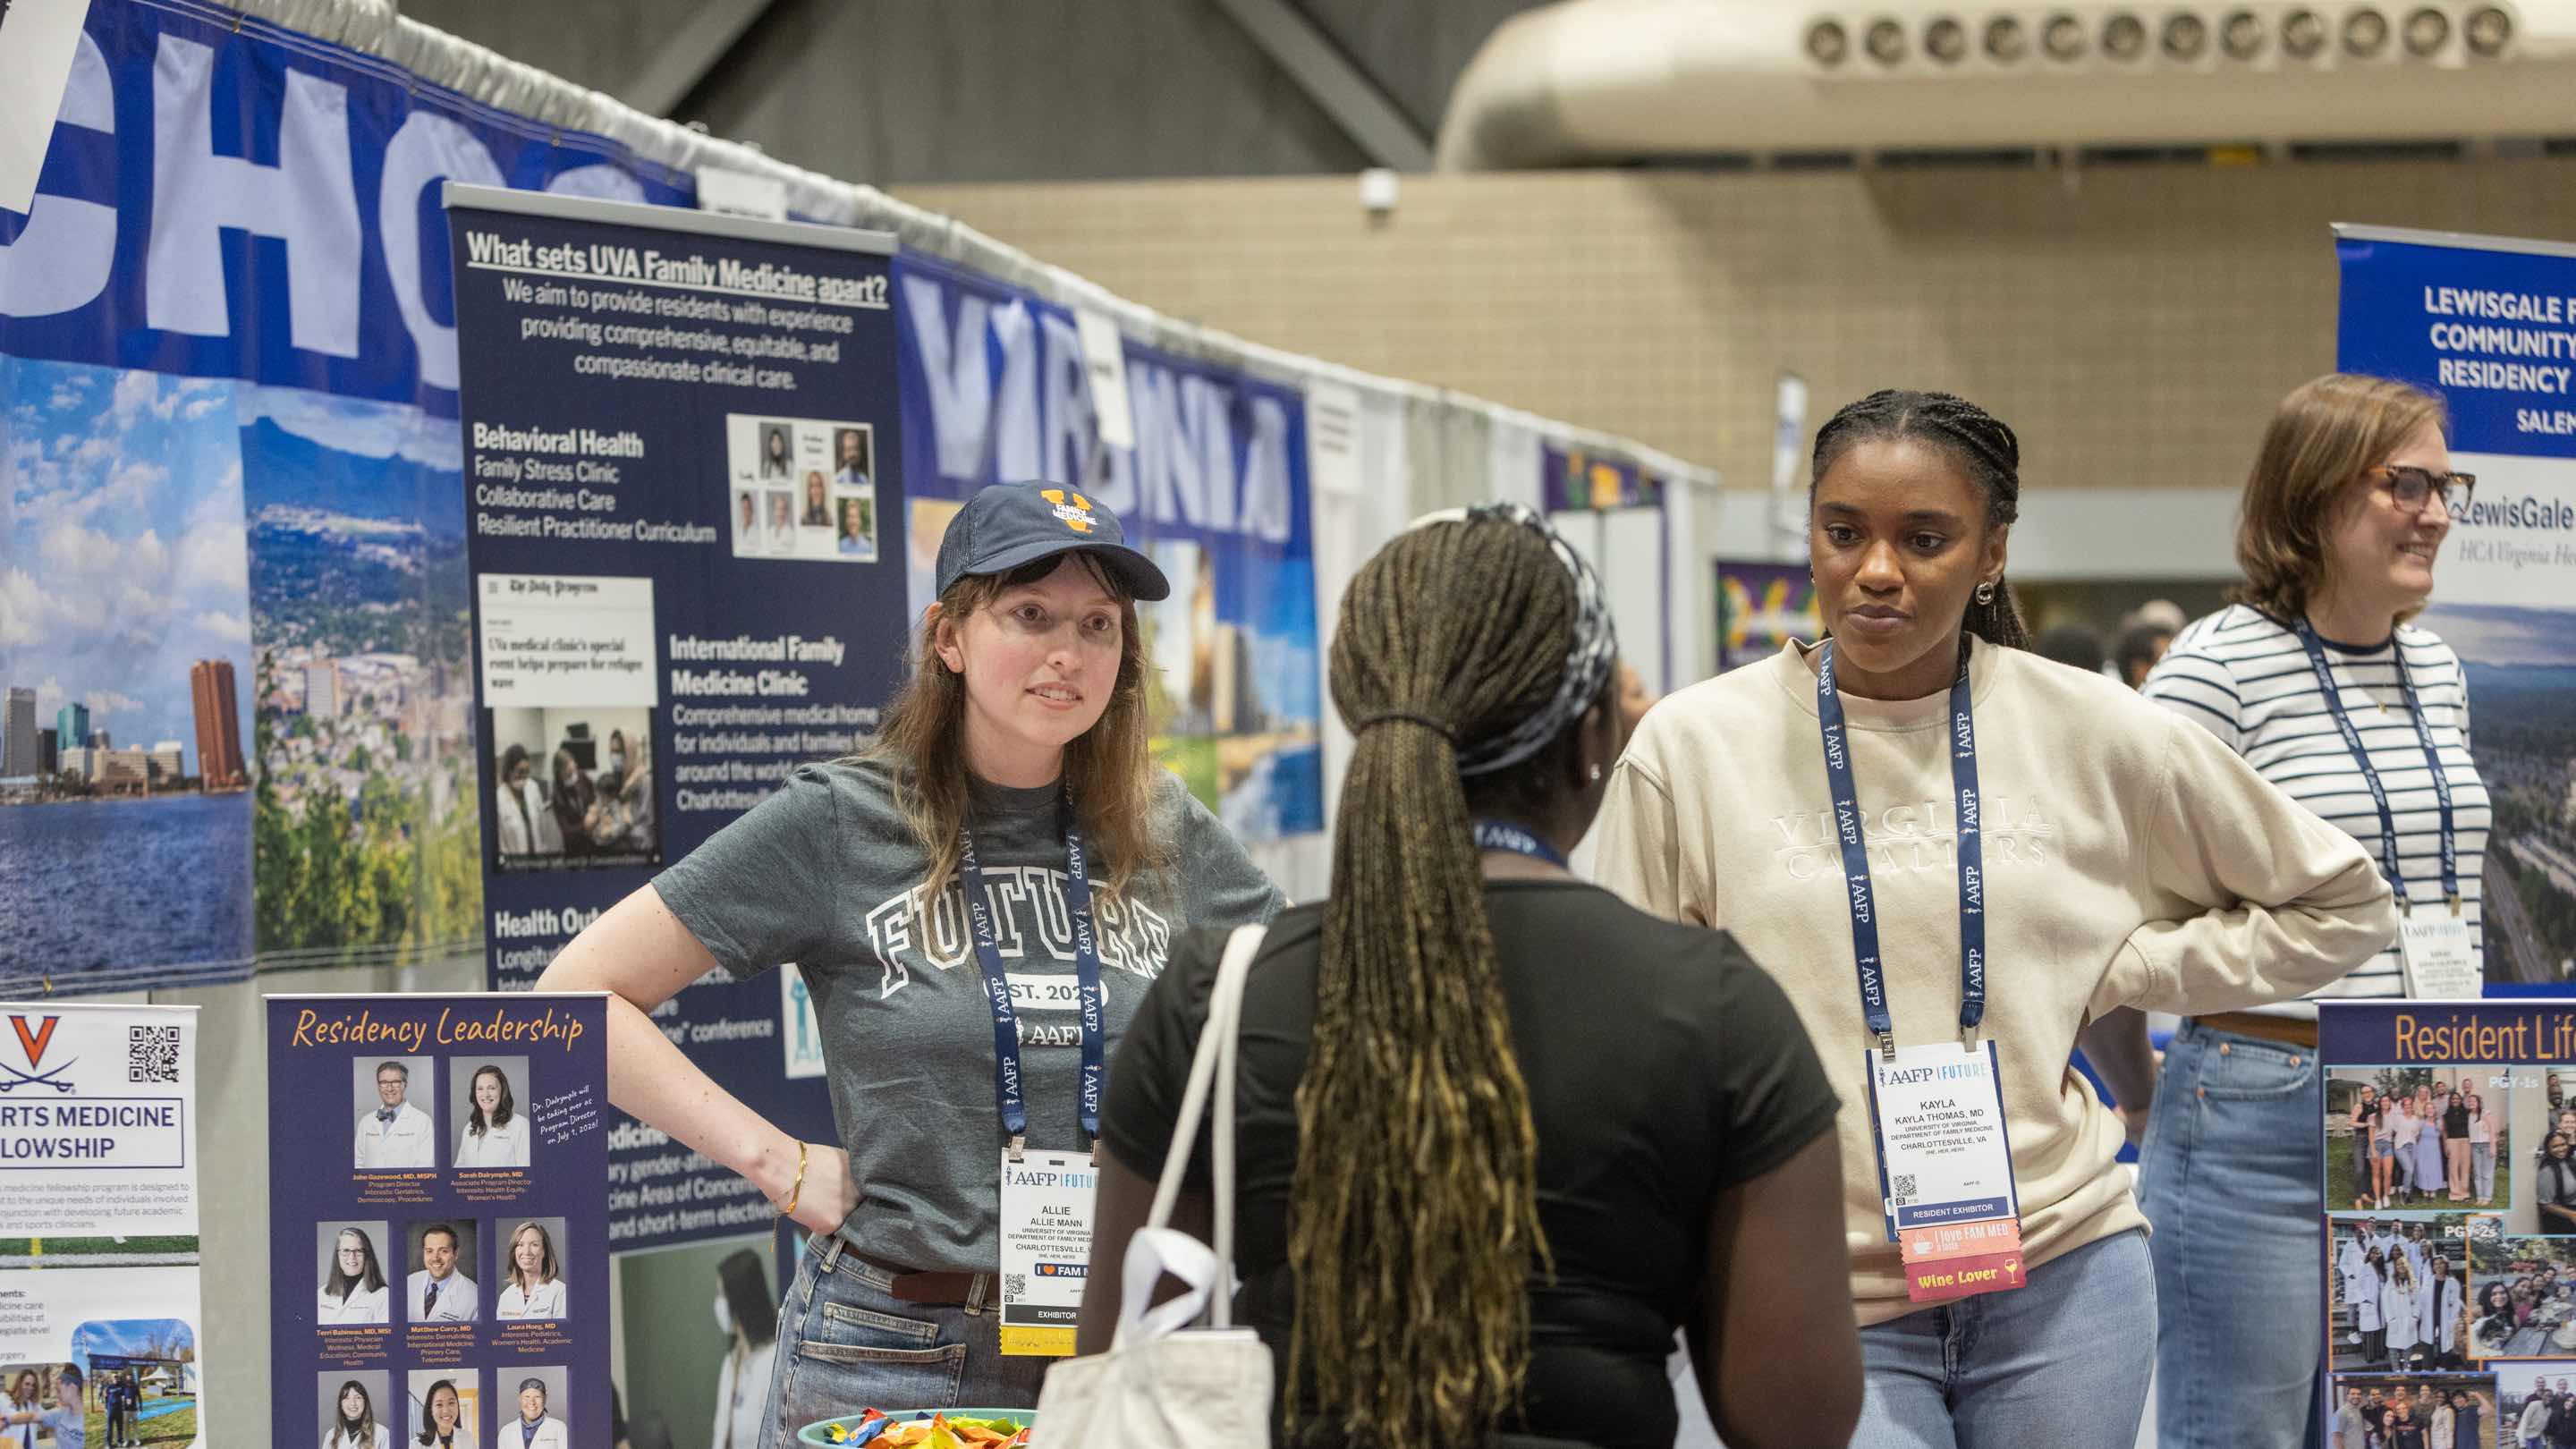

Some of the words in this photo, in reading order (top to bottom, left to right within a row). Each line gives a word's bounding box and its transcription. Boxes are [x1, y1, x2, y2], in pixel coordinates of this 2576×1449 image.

[467, 232, 532, 267] What
[537, 244, 587, 274] sets
[590, 246, 640, 278] UVA
[645, 251, 716, 288] Family
[719, 262, 814, 297] Medicine
[818, 275, 887, 306] apart?
[504, 278, 532, 302] We
[535, 284, 567, 306] aim
[570, 287, 589, 308] to
[592, 287, 652, 317] provide
[655, 297, 731, 323] residents
[733, 302, 766, 326] with
[768, 308, 853, 334] experience
[2425, 285, 2562, 323] LEWISGALE
[521, 316, 602, 345] providing
[605, 325, 731, 355] comprehensive,
[732, 334, 808, 361] equitable,
[809, 342, 839, 362] and
[575, 355, 699, 383] compassionate
[702, 361, 754, 386] clinical
[757, 369, 796, 390] care.
[2439, 358, 2571, 394] RESIDENCY
[474, 423, 576, 453] Behavioral
[580, 430, 644, 458] Health
[475, 455, 521, 482] Family
[525, 457, 572, 482] Stress
[576, 461, 620, 484] Clinic
[477, 484, 574, 510] Collaborative
[577, 489, 615, 512] Care
[1055, 504, 1087, 516] FAMILY
[478, 513, 540, 538] Resilient
[544, 515, 632, 540] Practitioner
[635, 520, 716, 542] Curriculum
[1053, 509, 1098, 526] MEDICINE
[510, 638, 549, 651] medical
[552, 639, 587, 651] clinic's
[590, 640, 625, 654] special
[671, 634, 784, 661] International
[787, 635, 844, 665] Family
[518, 657, 544, 672] helps
[547, 660, 588, 674] prepare
[591, 657, 605, 669] for
[672, 671, 755, 696] Medicine
[758, 672, 808, 696] Clinic
[1820, 664, 1831, 696] AAFP
[673, 704, 782, 727] Comprehensive
[784, 705, 835, 725] medical
[837, 705, 878, 725] home
[674, 731, 695, 752] for
[699, 731, 771, 752] individuals
[773, 732, 800, 752] and
[802, 731, 850, 751] families
[1957, 712, 1971, 749] AAFP
[1826, 734, 1843, 770] AAFP
[675, 761, 733, 783] around
[734, 761, 756, 782] the
[758, 761, 792, 781] world
[1770, 795, 2048, 843] VIRGIIA
[1962, 789, 1977, 826] AAFP
[1839, 809, 1858, 845] AAFP
[1069, 843, 1082, 879] AAFP
[1789, 837, 2046, 879] CAALIRS
[1967, 866, 1981, 905] AAFP
[1852, 883, 1868, 923] AAFP
[495, 908, 560, 938] Health
[972, 902, 991, 938] AAFP
[1076, 918, 1091, 954] AAFP
[1970, 948, 1982, 988] AAFP
[991, 978, 1010, 1013] AAFP
[1046, 986, 1080, 1000] 202
[1863, 966, 1880, 1006] AAFP
[1084, 994, 1097, 1032] AAFP
[292, 1008, 428, 1053] Residency
[436, 1007, 584, 1052] Leadership
[691, 1017, 774, 1043] conference
[2395, 1014, 2529, 1060] Resident
[1004, 1056, 1018, 1096] AAFP
[1889, 1068, 1933, 1085] AAFP
[1942, 1063, 1987, 1080] FUTURE
[532, 1103, 543, 1113] Dr.
[545, 1090, 577, 1108] Dalrymple
[579, 1084, 589, 1094] will
[1085, 1073, 1097, 1113] AAFP
[1920, 1099, 1955, 1110] KAYLA
[1, 1106, 49, 1127] RTS
[56, 1106, 174, 1127] MEDICINE
[541, 1122, 569, 1135] Program
[570, 1110, 597, 1124] Director
[547, 1108, 568, 1119] taking
[570, 1102, 582, 1112] over
[1894, 1114, 1925, 1125] KAYLA
[1926, 1111, 1968, 1123] THOMAS,
[1970, 1109, 1984, 1117] MD
[557, 1131, 569, 1143] July
[1891, 1131, 1932, 1140] DEPARTMENT
[1964, 1125, 1994, 1133] MEDICINE
[1905, 1124, 1940, 1132] UNIVERSITY
[1952, 1120, 1978, 1128] VIRGINIA
[1, 1138, 114, 1158] LOWSHIP
[1901, 1138, 1975, 1151] CHARLOTTESVILLE,
[47, 1182, 92, 1195] fellowship
[93, 1182, 130, 1195] program
[140, 1182, 179, 1194] designed
[1014, 1172, 1056, 1186] AAFP
[35, 1195, 65, 1207] unique
[67, 1194, 94, 1205] needs
[106, 1193, 151, 1204] individuals
[153, 1194, 189, 1203] involved
[1042, 1206, 1071, 1215] ALLIE
[1912, 1208, 1950, 1218] RESIDENT
[1953, 1203, 1994, 1215] EXHIBITOR
[24, 1220, 52, 1231] sports
[64, 1208, 112, 1219] developing
[114, 1207, 140, 1216] future
[141, 1207, 182, 1216] academic
[637, 1208, 716, 1233] short-term
[1030, 1217, 1055, 1226] ALLIE
[1057, 1219, 1082, 1227] MANN
[1964, 1225, 1987, 1240] FAM
[1987, 1223, 2009, 1237] MED
[2444, 1225, 2498, 1238] PGY-2s
[1016, 1243, 1087, 1253] CHARLOTTESVILLE,
[1058, 1267, 1080, 1275] FAM
[1918, 1275, 1954, 1289] Wine
[1958, 1268, 1997, 1284] Lover
